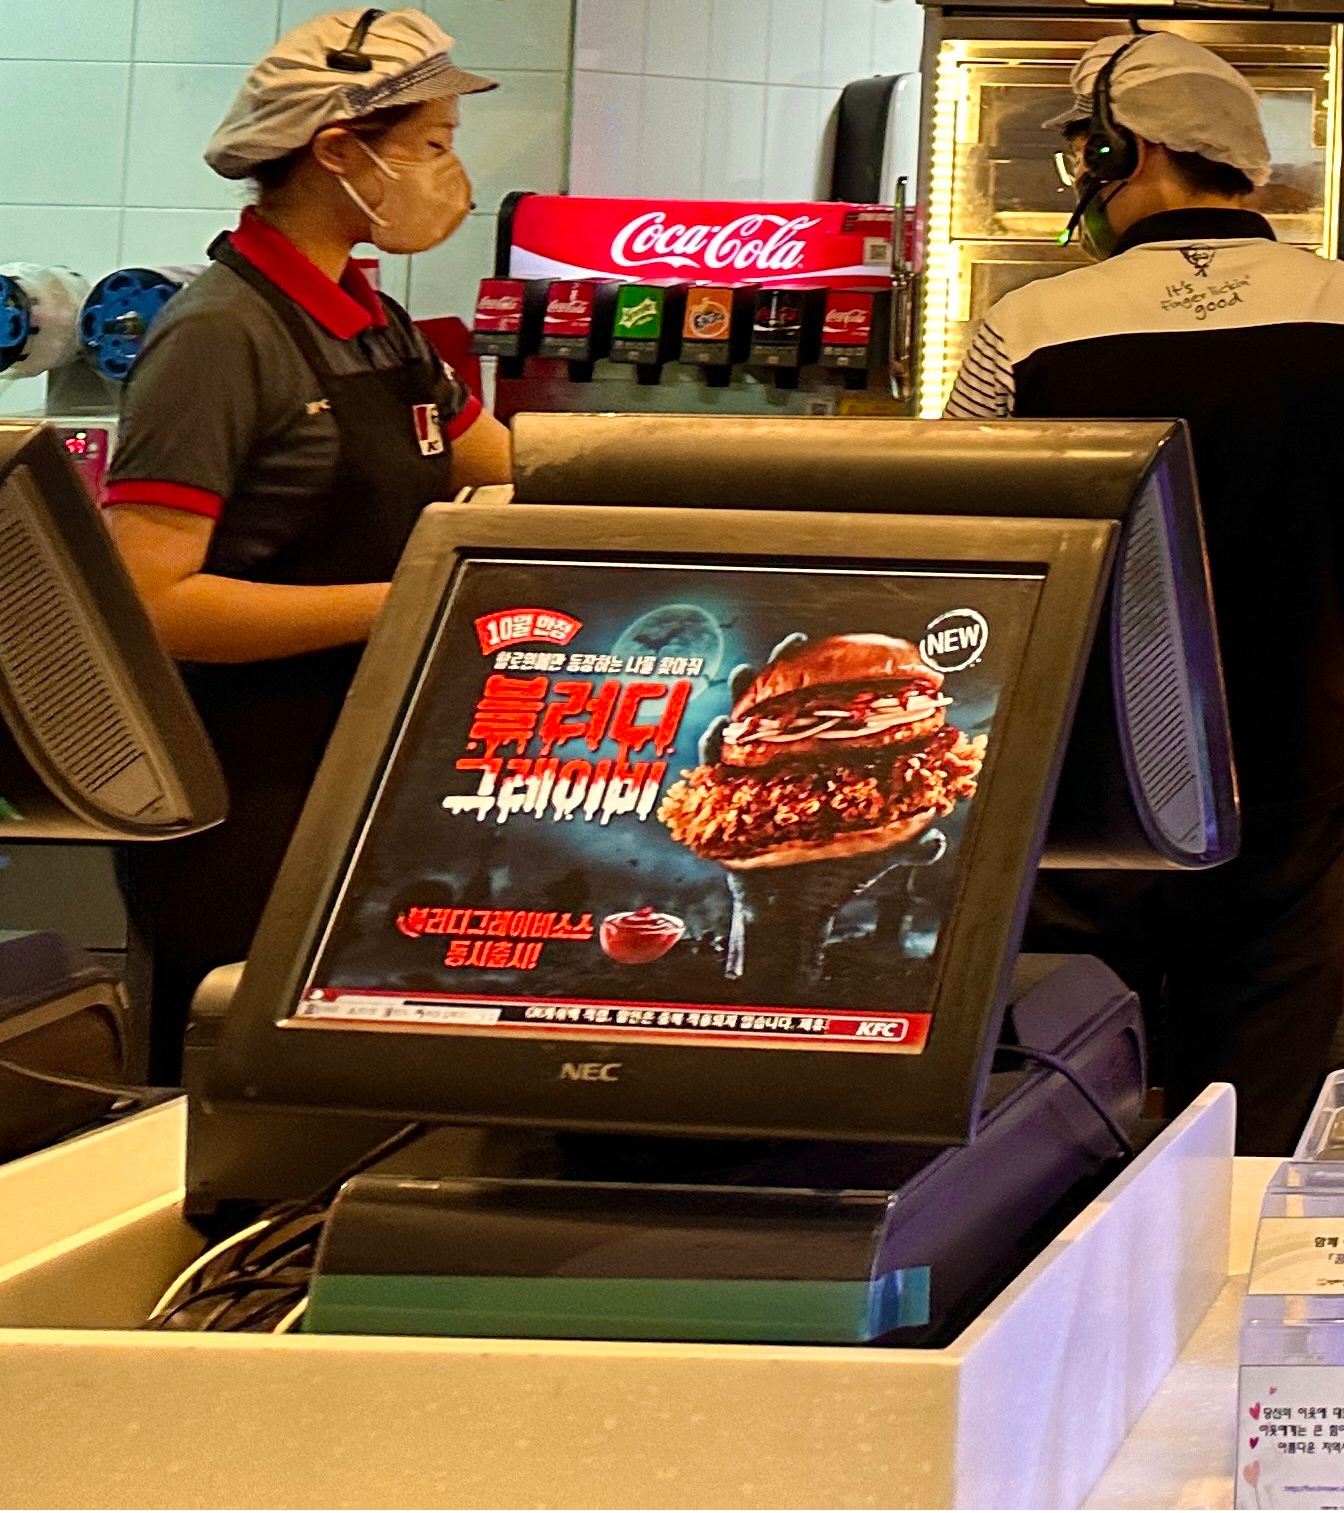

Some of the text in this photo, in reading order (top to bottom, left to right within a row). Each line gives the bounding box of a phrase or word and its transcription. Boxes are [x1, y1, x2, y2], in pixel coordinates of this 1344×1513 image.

[611, 211, 822, 271] Coca-Cola
[1194, 292, 1243, 320] good
[486, 614, 534, 646] 10월
[925, 622, 980, 658] NEW
[566, 653, 625, 674] 등장하는
[625, 655, 656, 674] 나를
[467, 674, 693, 757] 블러디
[442, 757, 668, 826] 그레이비
[855, 1020, 898, 1038] KFC
[559, 1062, 623, 1083] NEC
